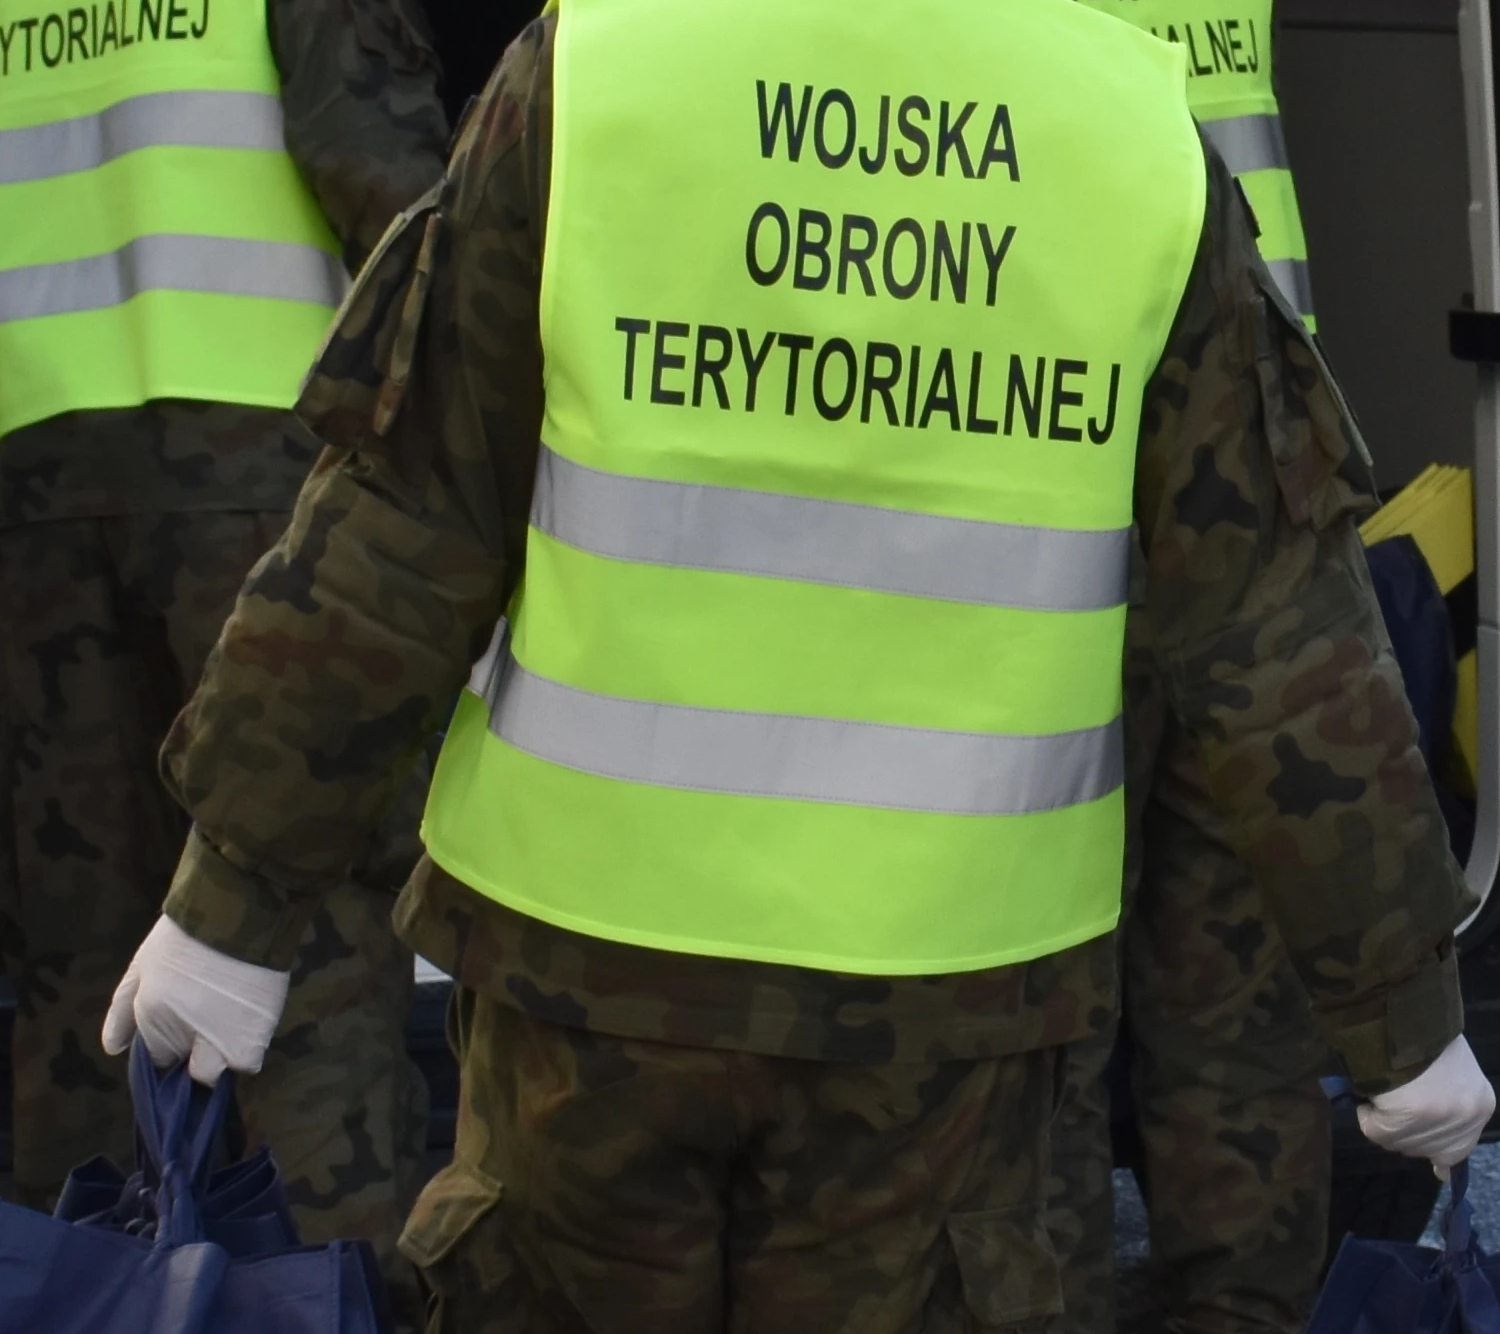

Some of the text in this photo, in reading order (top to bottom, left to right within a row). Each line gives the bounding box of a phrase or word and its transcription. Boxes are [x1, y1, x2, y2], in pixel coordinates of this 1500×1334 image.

[755, 79, 1021, 183] WOJSKA
[745, 202, 1017, 307] OBRONY
[615, 317, 1121, 446] TERYTORIALNEJ
